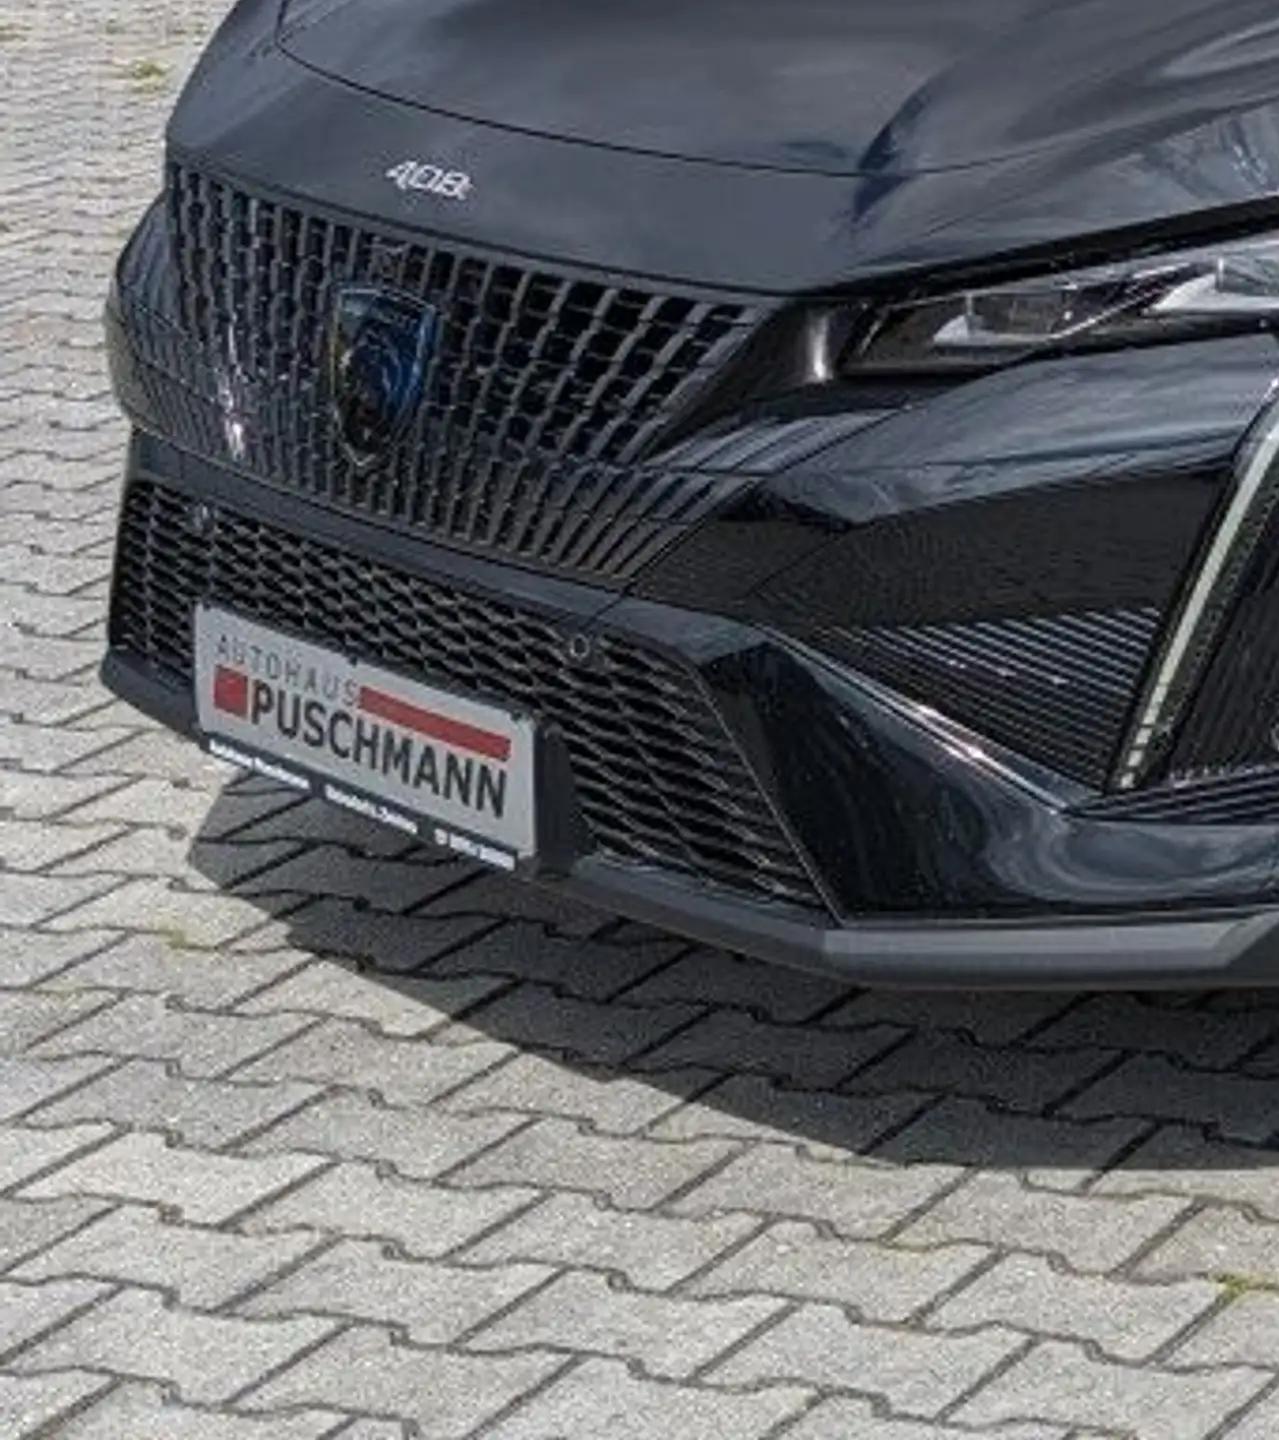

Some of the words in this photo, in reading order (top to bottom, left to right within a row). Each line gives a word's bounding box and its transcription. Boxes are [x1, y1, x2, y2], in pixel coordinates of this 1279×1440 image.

[385, 160, 474, 200] 408
[217, 633, 359, 707] AUTOHAUS
[249, 677, 509, 819] PUSCHMANN
